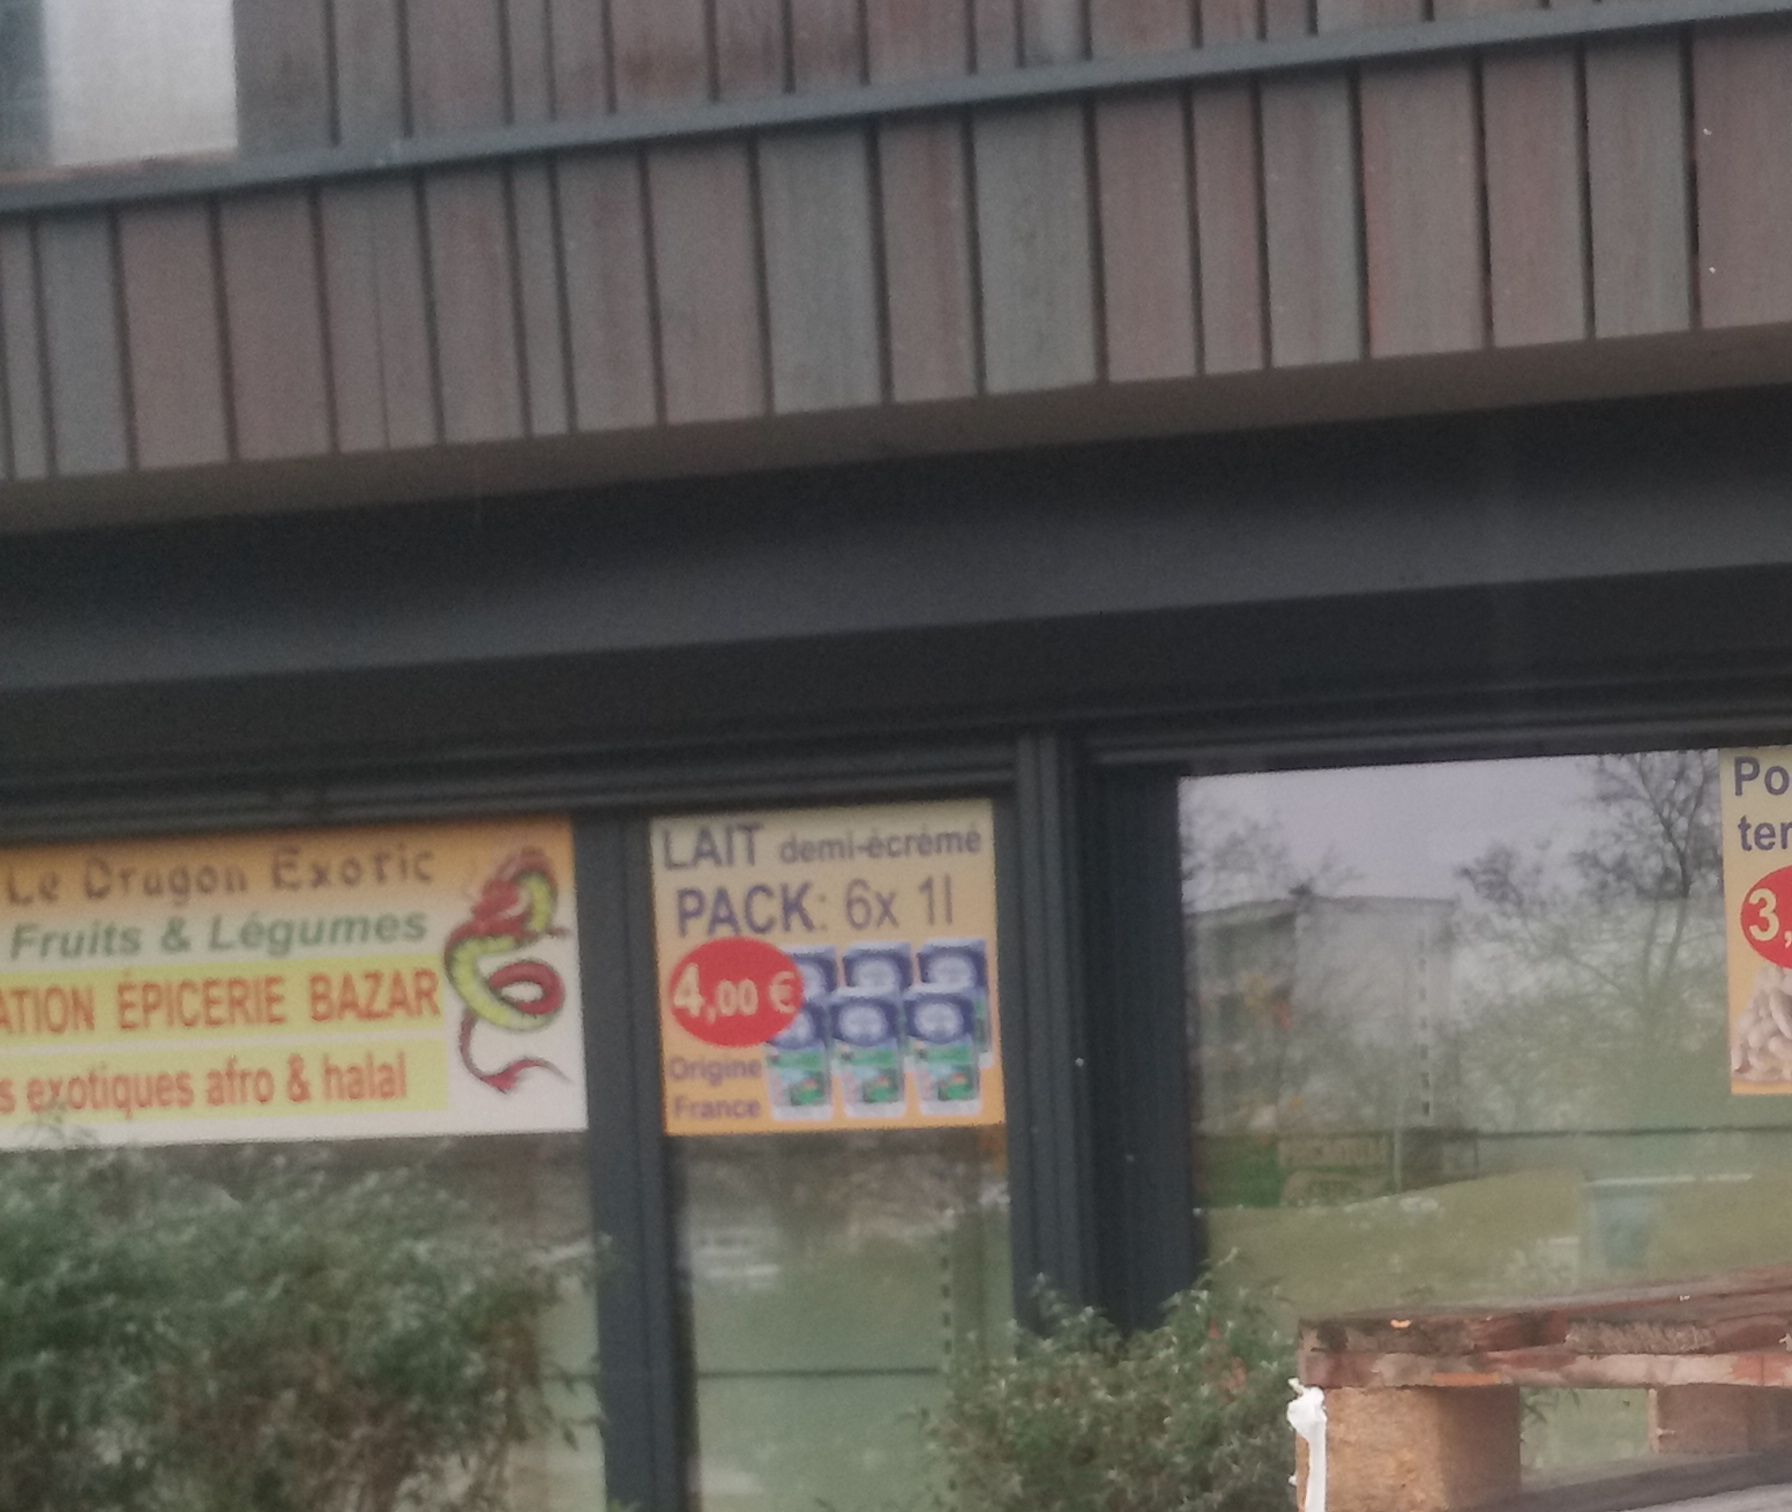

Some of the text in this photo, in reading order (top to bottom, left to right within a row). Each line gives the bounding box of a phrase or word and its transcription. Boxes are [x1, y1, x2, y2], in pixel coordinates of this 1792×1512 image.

[664, 822, 764, 870] LAIT
[7, 844, 435, 906] Le Dragon Exotic
[10, 909, 427, 959] Fruits & Légumes
[676, 881, 827, 937] PACK:
[846, 879, 899, 930] 6x
[309, 968, 441, 1023] BAZAR
[672, 963, 796, 1025] 4,00 €
[27, 1066, 194, 1118] exotiques
[206, 1056, 274, 1106] afro
[287, 1053, 311, 1104] &
[323, 1051, 407, 1102] halal
[670, 1055, 762, 1085] Origine
[674, 1099, 761, 1120] France
